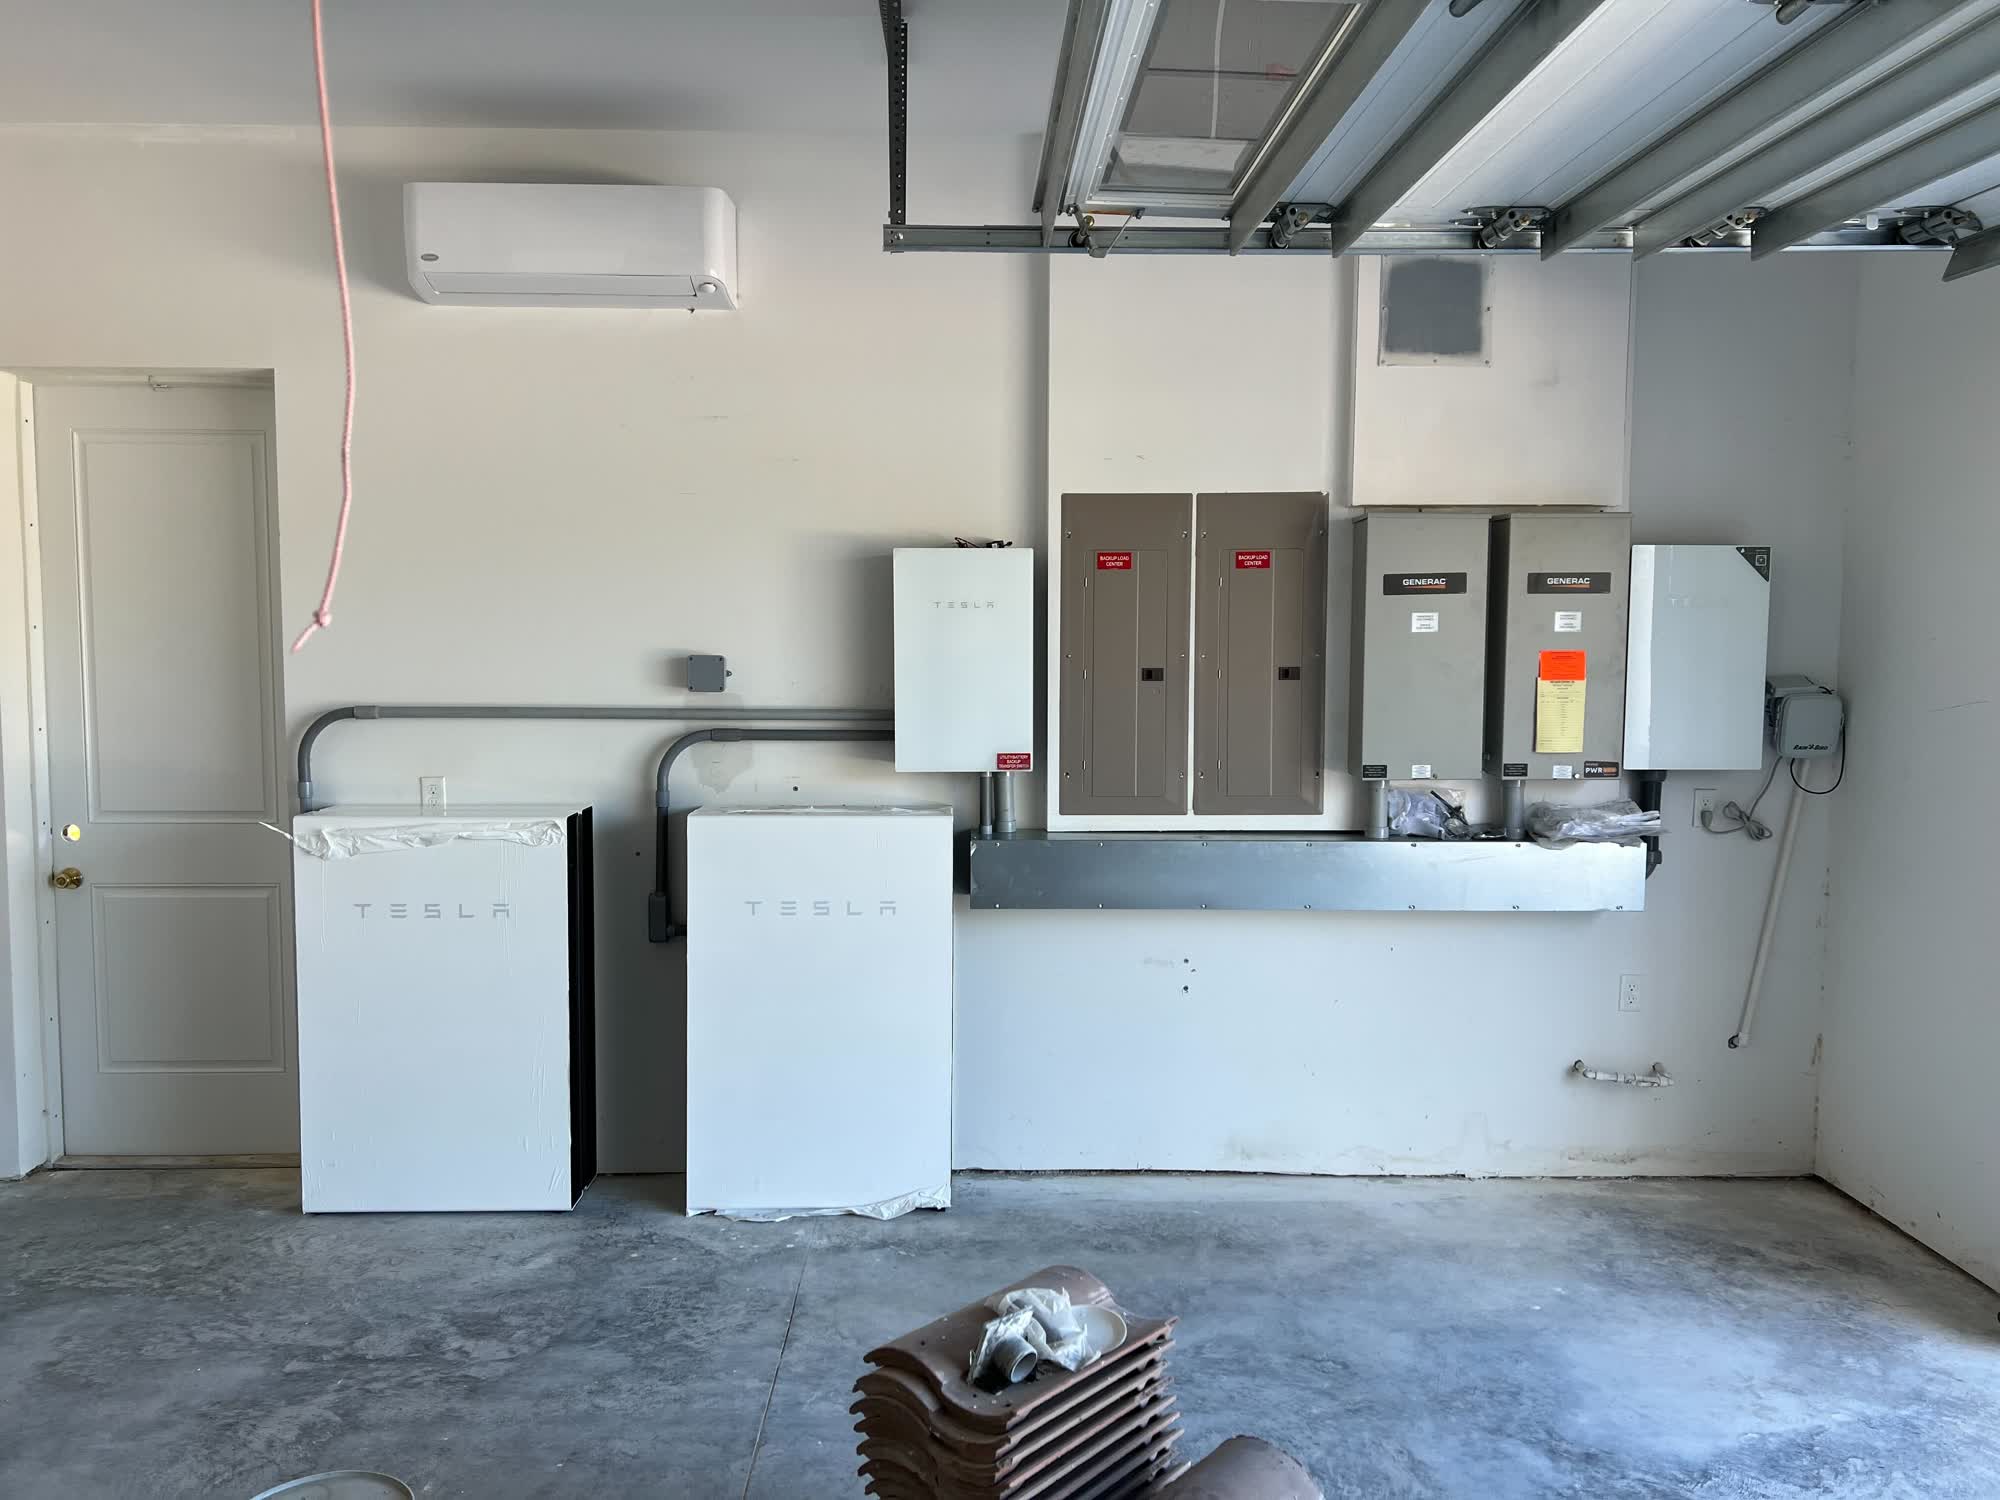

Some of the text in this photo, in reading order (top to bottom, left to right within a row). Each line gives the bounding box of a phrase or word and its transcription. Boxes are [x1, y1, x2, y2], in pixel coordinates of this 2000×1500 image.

[1402, 578, 1447, 586] GENERAC
[1546, 577, 1591, 585] GENERAC
[933, 601, 995, 609] TESLA
[352, 903, 510, 919] TESLA
[745, 900, 897, 917] TESLA
